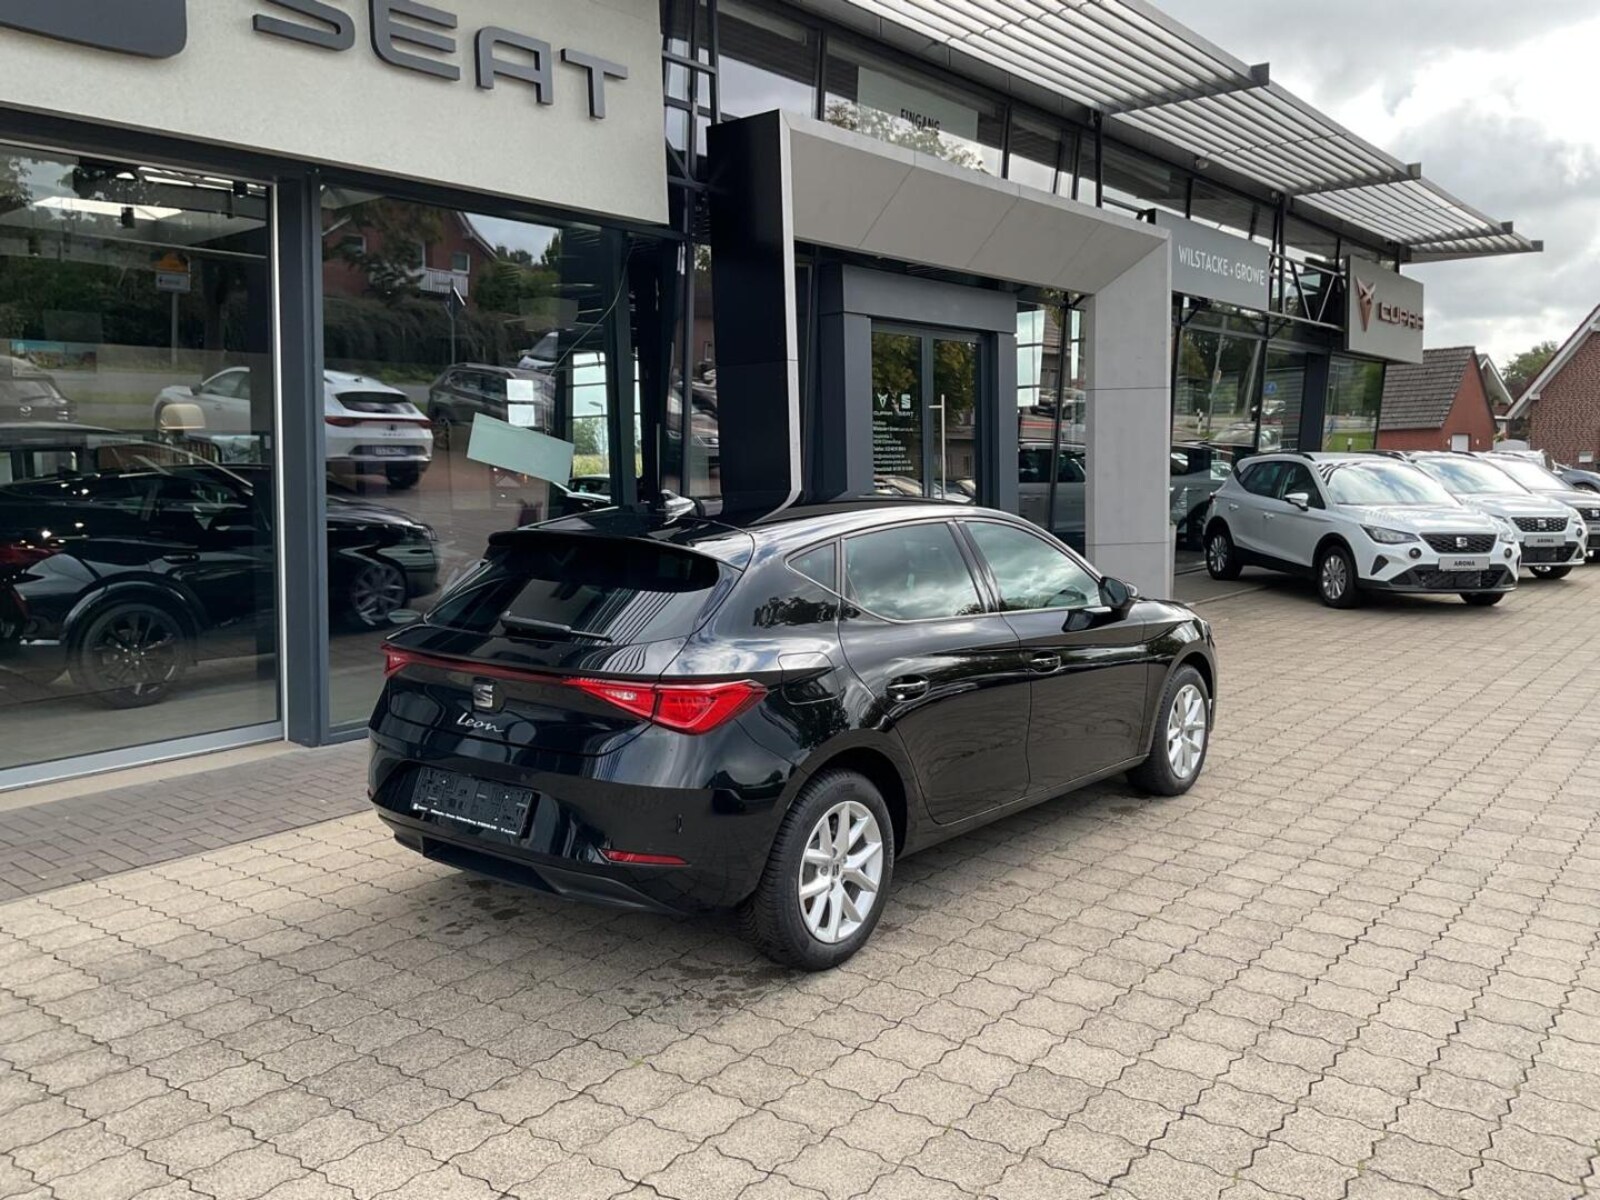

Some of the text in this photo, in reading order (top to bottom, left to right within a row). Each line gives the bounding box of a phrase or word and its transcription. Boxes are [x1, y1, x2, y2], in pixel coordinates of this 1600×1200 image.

[253, 0, 629, 120] SEAT
[900, 108, 941, 130] EINGANG
[1178, 244, 1229, 277] WILSTACKE
[1235, 262, 1266, 287] GROWE
[456, 711, 505, 733] Leon
